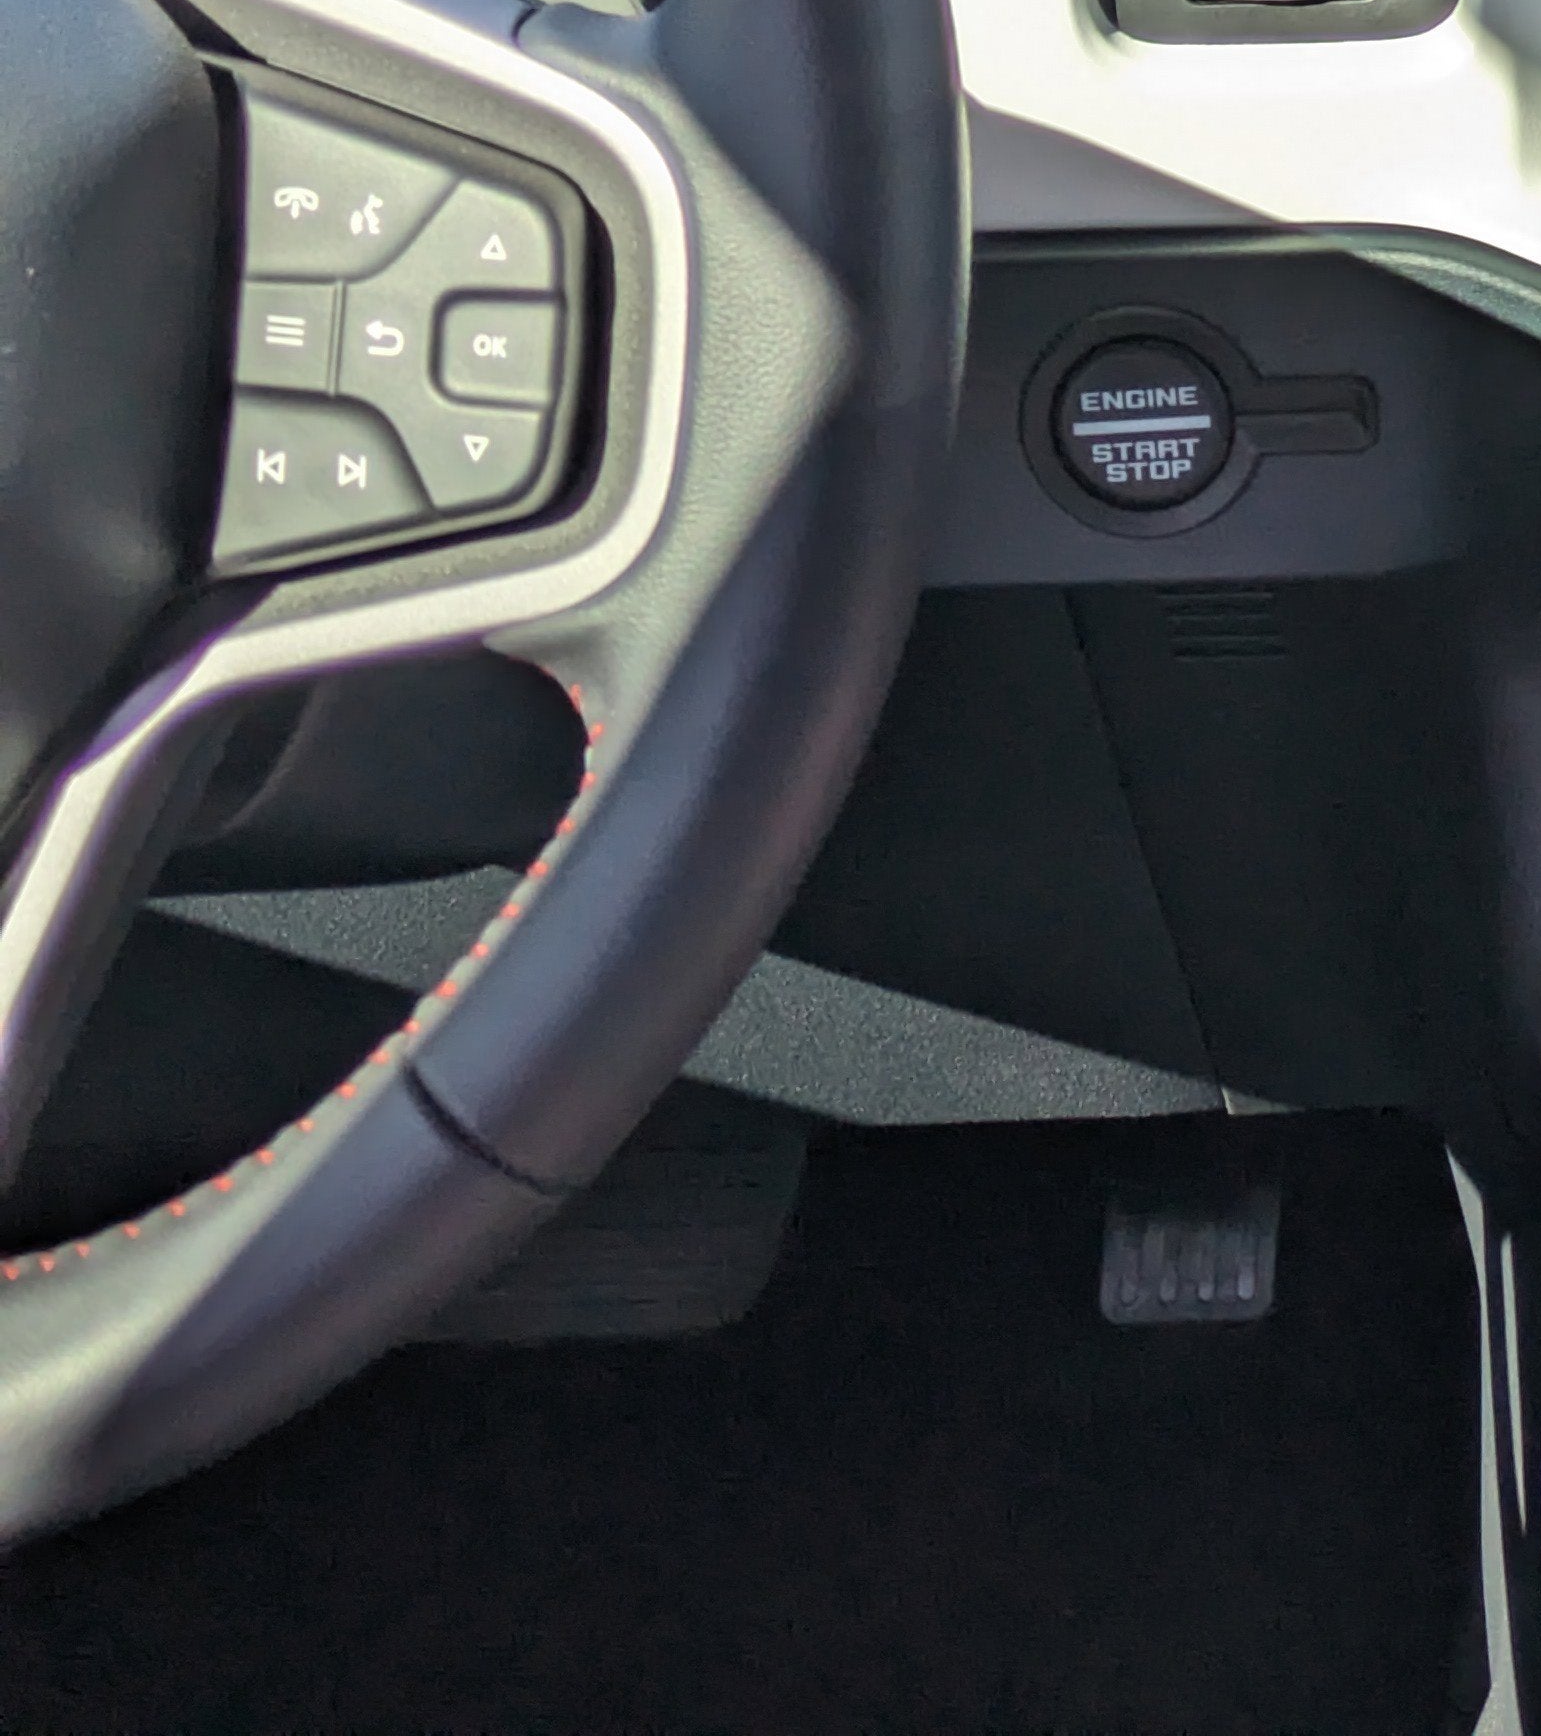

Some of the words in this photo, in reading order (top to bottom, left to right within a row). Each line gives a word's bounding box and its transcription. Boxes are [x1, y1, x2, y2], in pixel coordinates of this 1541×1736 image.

[472, 333, 508, 359] OK
[1080, 385, 1199, 412] ENGINE
[1090, 436, 1201, 464] START
[1104, 458, 1193, 484] STOP
